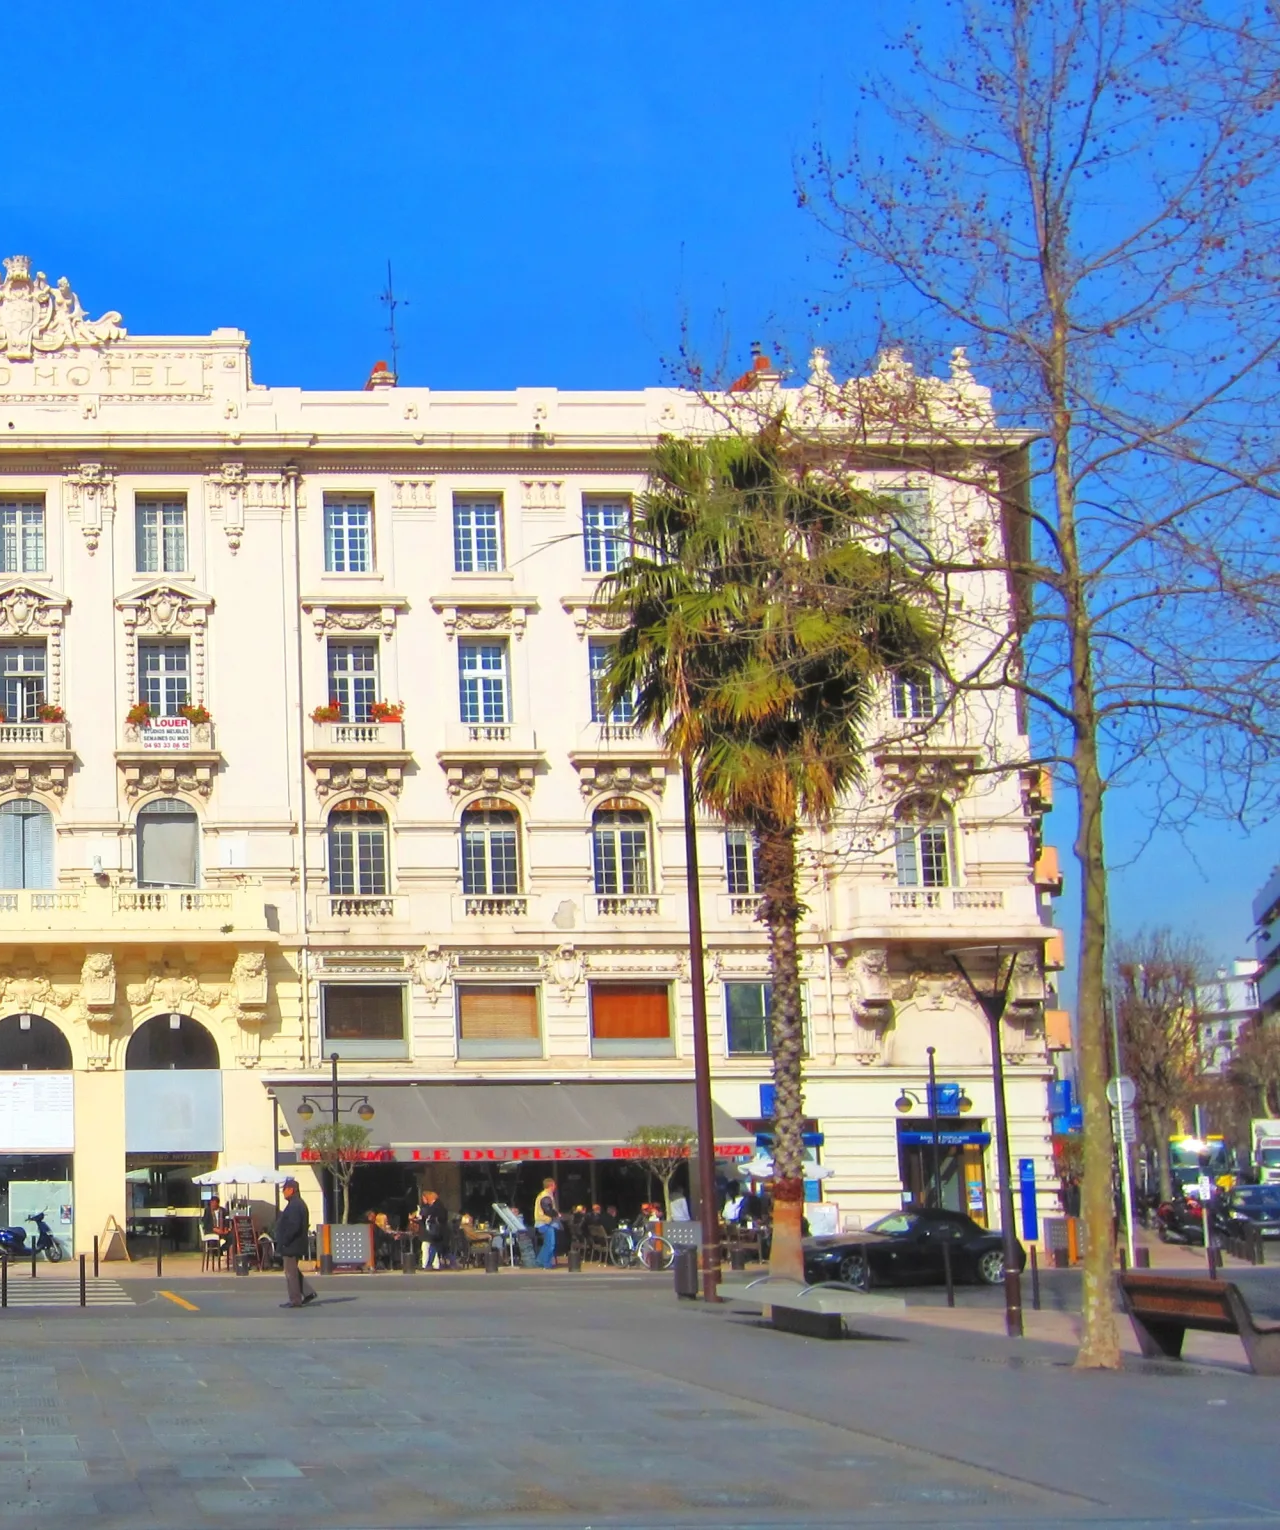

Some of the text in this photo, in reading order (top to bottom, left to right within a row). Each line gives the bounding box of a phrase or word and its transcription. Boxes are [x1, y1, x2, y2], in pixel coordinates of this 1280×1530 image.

[32, 366, 187, 387] HOTEL
[155, 719, 188, 727] LOUER
[412, 1148, 595, 1161] LE DUPLEX
